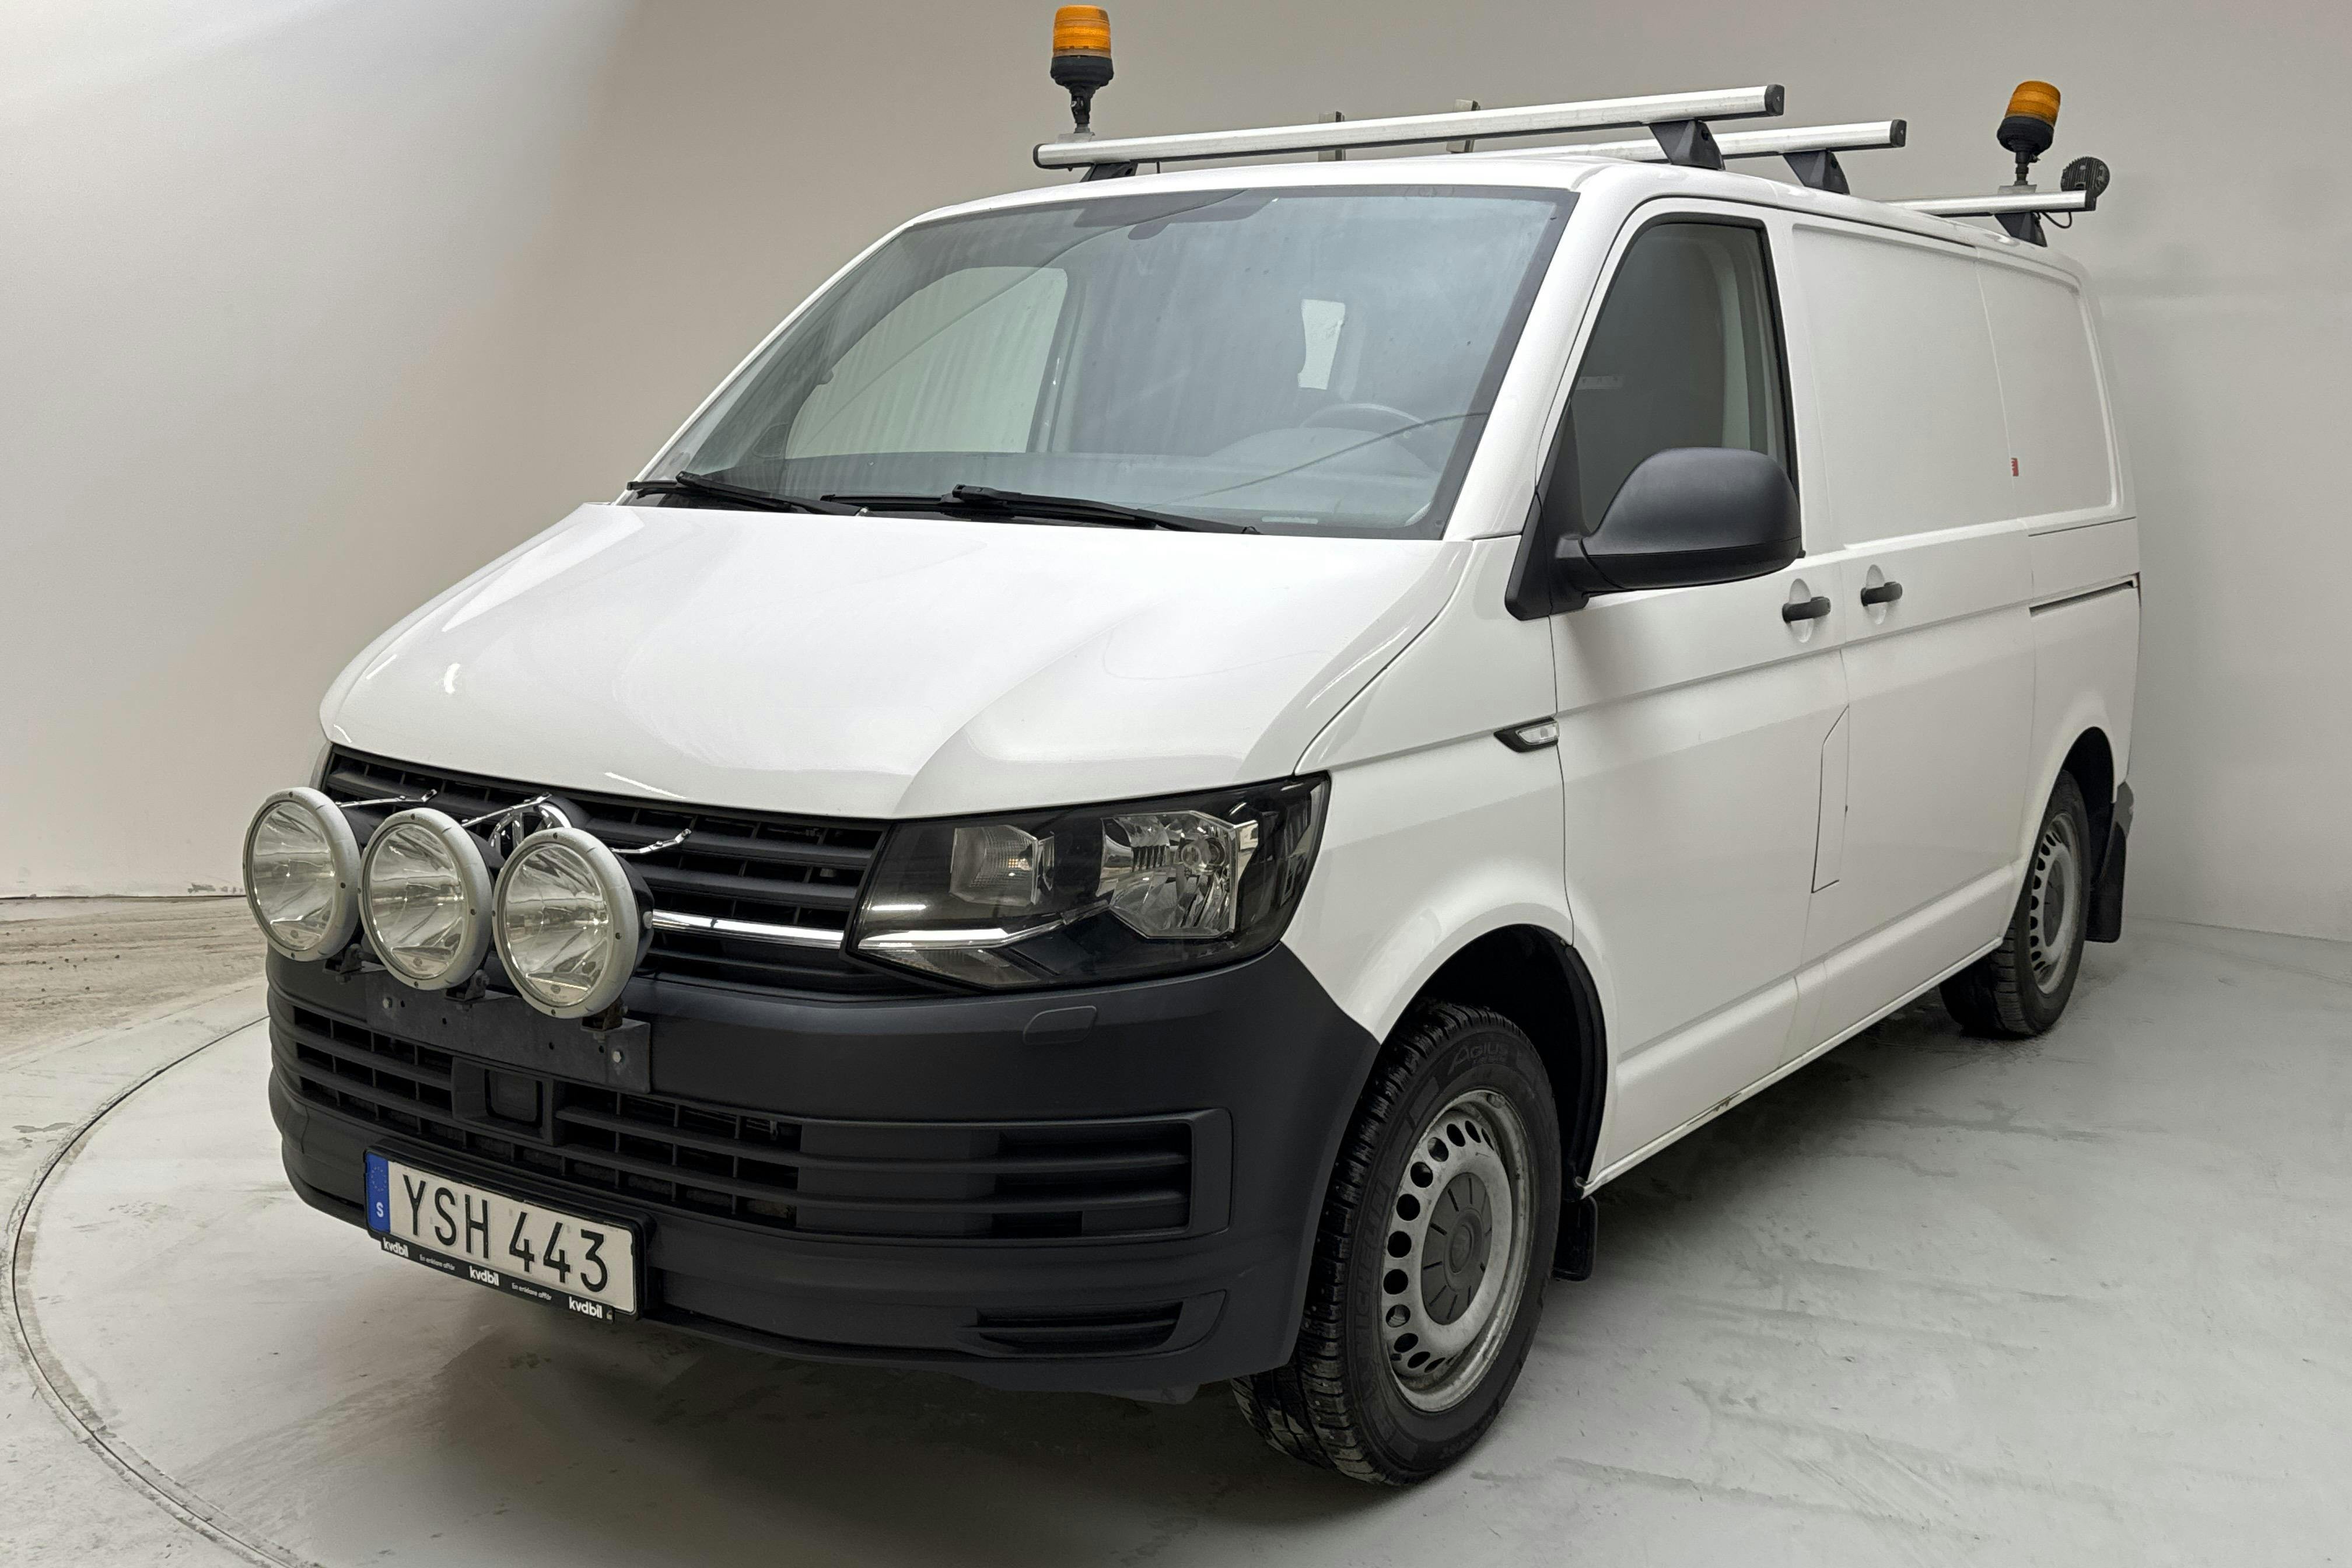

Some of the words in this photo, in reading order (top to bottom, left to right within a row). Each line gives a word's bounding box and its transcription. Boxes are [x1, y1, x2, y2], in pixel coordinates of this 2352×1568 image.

[376, 1202, 384, 1218] S
[403, 1174, 489, 1259] YSH
[509, 1211, 608, 1292] 443
[383, 1237, 408, 1257] kvdbil
[469, 1265, 500, 1286] kvdbil
[569, 1296, 603, 1318] kvdbil
